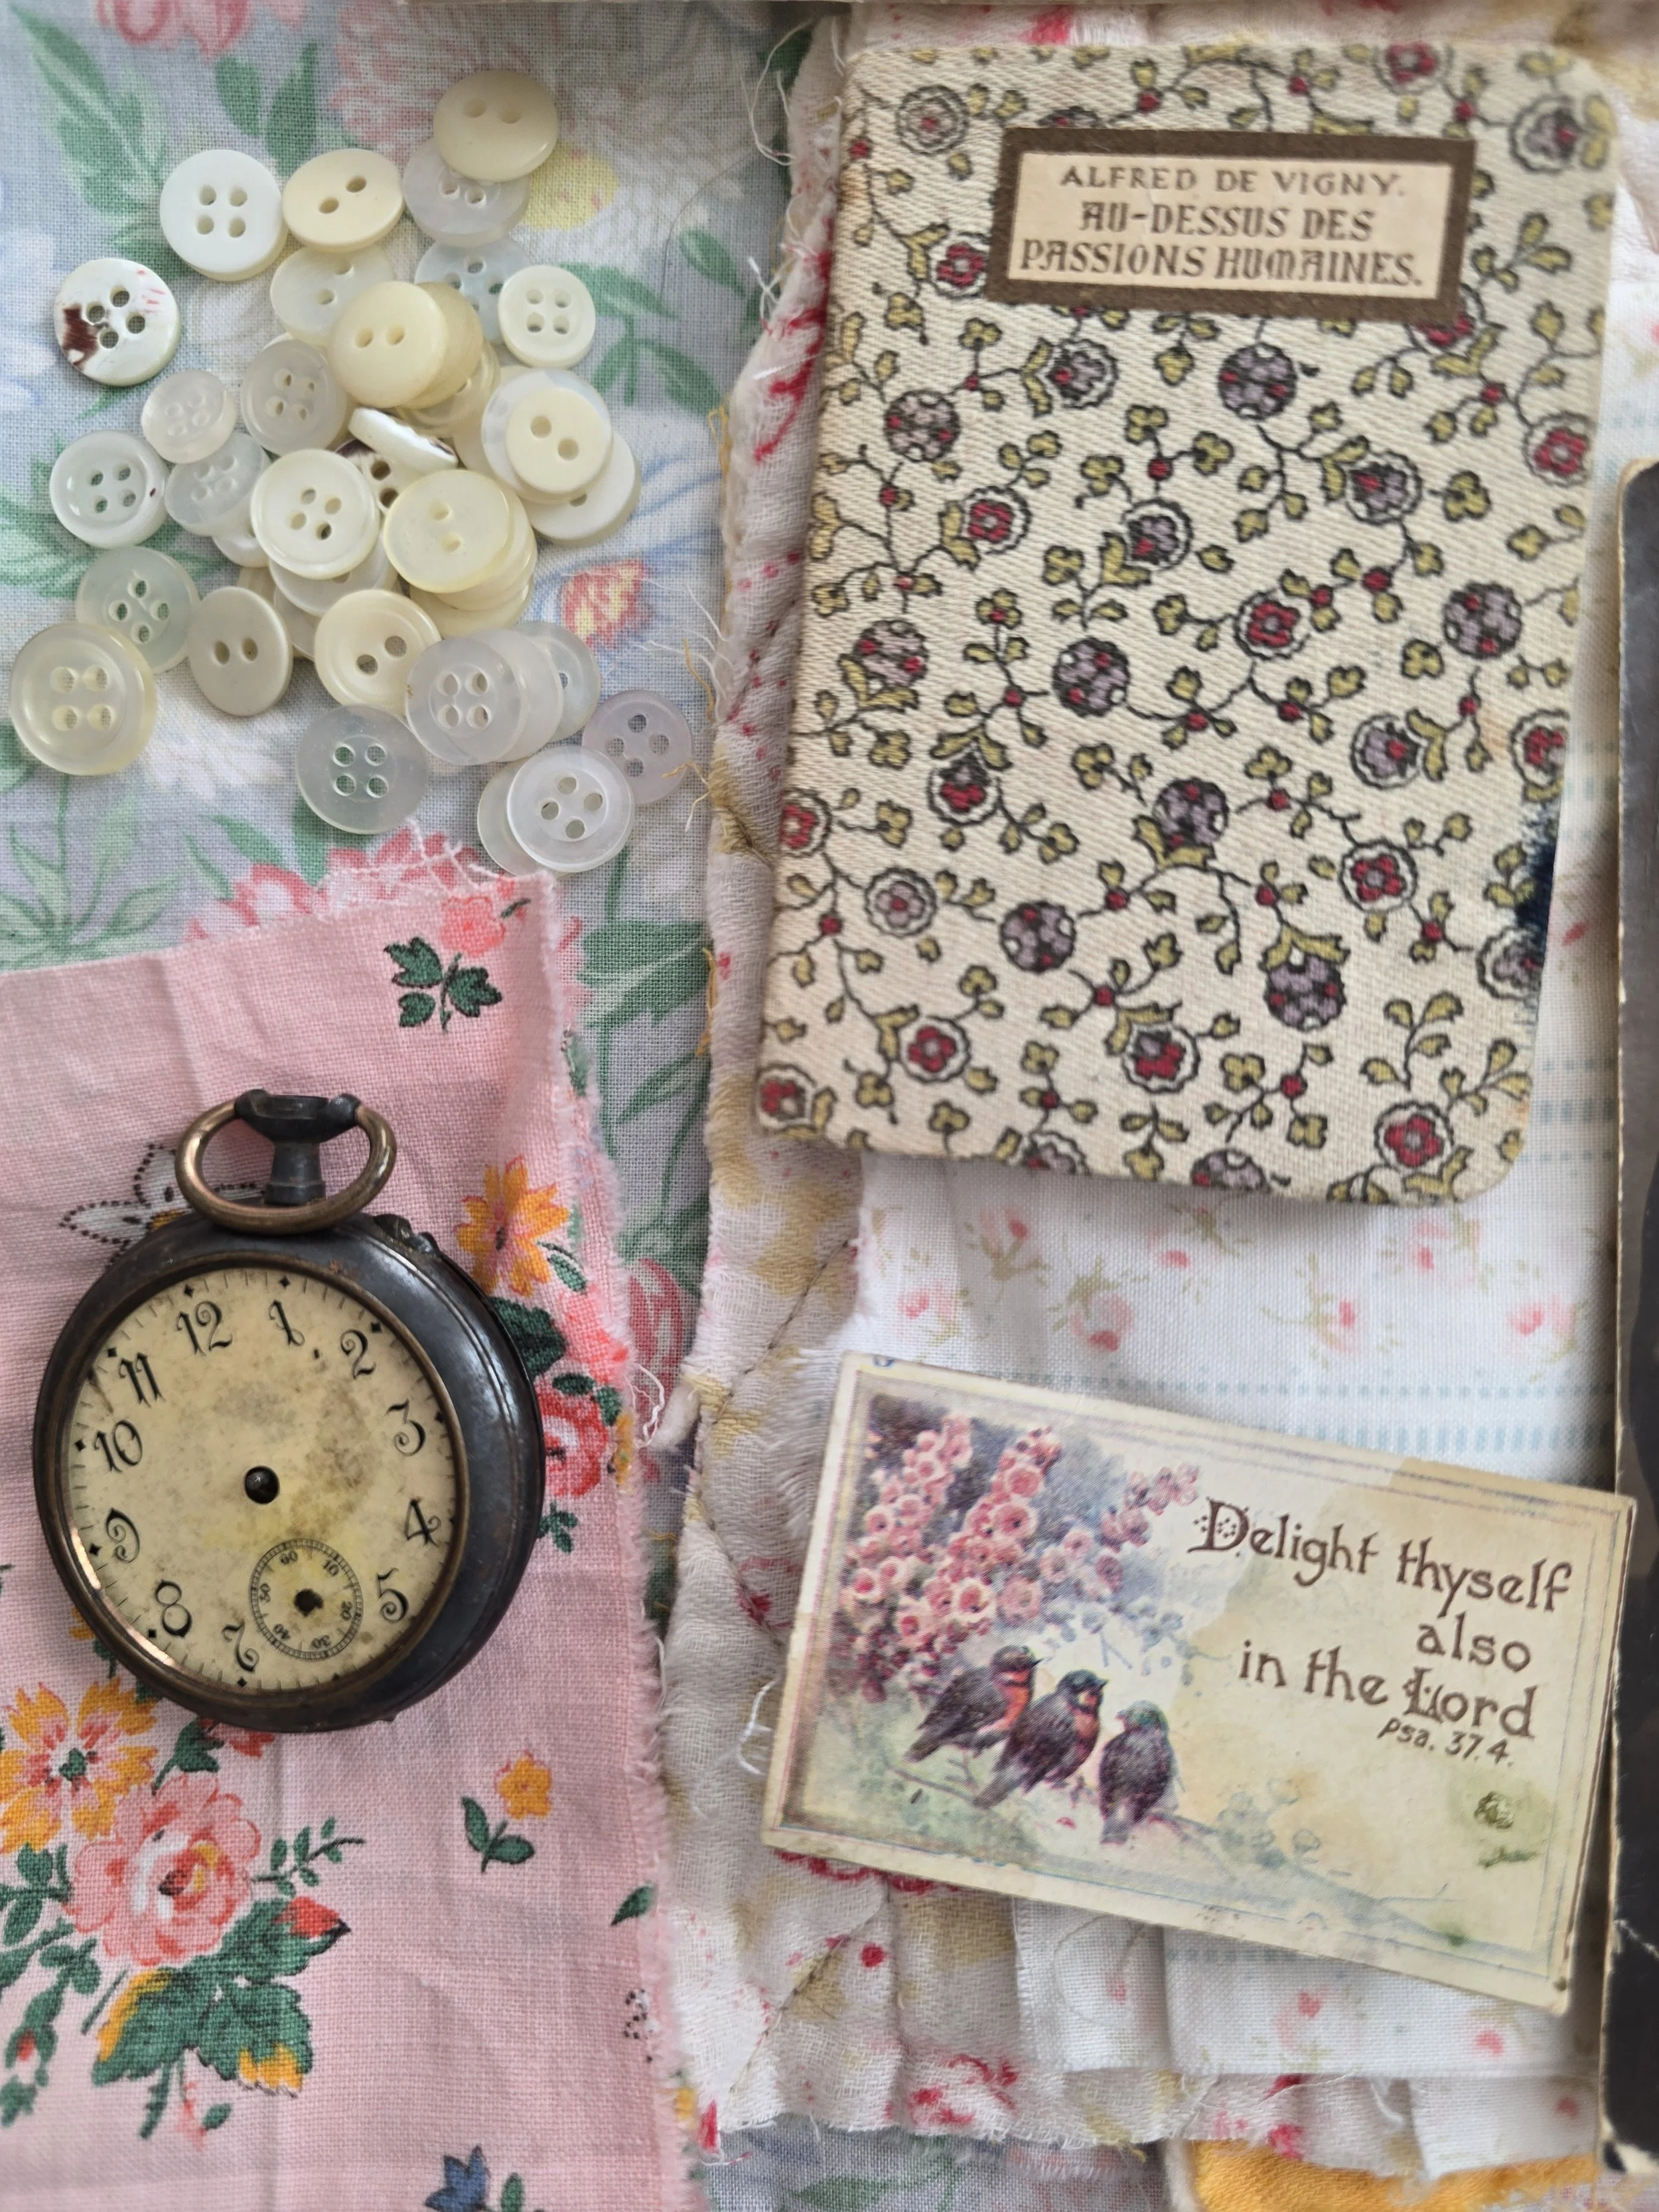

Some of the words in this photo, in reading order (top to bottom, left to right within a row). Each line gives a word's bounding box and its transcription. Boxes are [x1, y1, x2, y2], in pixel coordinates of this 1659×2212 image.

[1060, 165, 1198, 190] ALFRED
[1215, 167, 1258, 192] DE
[1271, 171, 1406, 197] VIGNY.
[1079, 201, 1290, 238] AU-DESSUS
[1301, 208, 1375, 242] DES
[1019, 238, 1208, 276] PASSIONS
[1214, 247, 1423, 287] HUMAINES.
[176, 1300, 234, 1357] 12
[269, 1299, 305, 1347] 1
[117, 1352, 166, 1408] 11
[340, 1329, 376, 1380] 2
[92, 1419, 143, 1473] 10
[385, 1398, 427, 1456] 3
[105, 1507, 141, 1564] 9
[403, 1497, 442, 1547] 4
[323, 1559, 340, 1577] 10
[1187, 1497, 1380, 1587] Delight
[1396, 1536, 1572, 1619] thyself
[154, 1580, 192, 1638] 8
[340, 1600, 354, 1621] 20
[376, 1568, 408, 1623] 5
[221, 1620, 260, 1672] 7
[310, 1635, 331, 1649] 30
[1415, 1611, 1531, 1672] also
[1238, 1640, 1286, 1688] in
[1303, 1645, 1388, 1706] the
[1402, 1666, 1536, 1740] Lord
